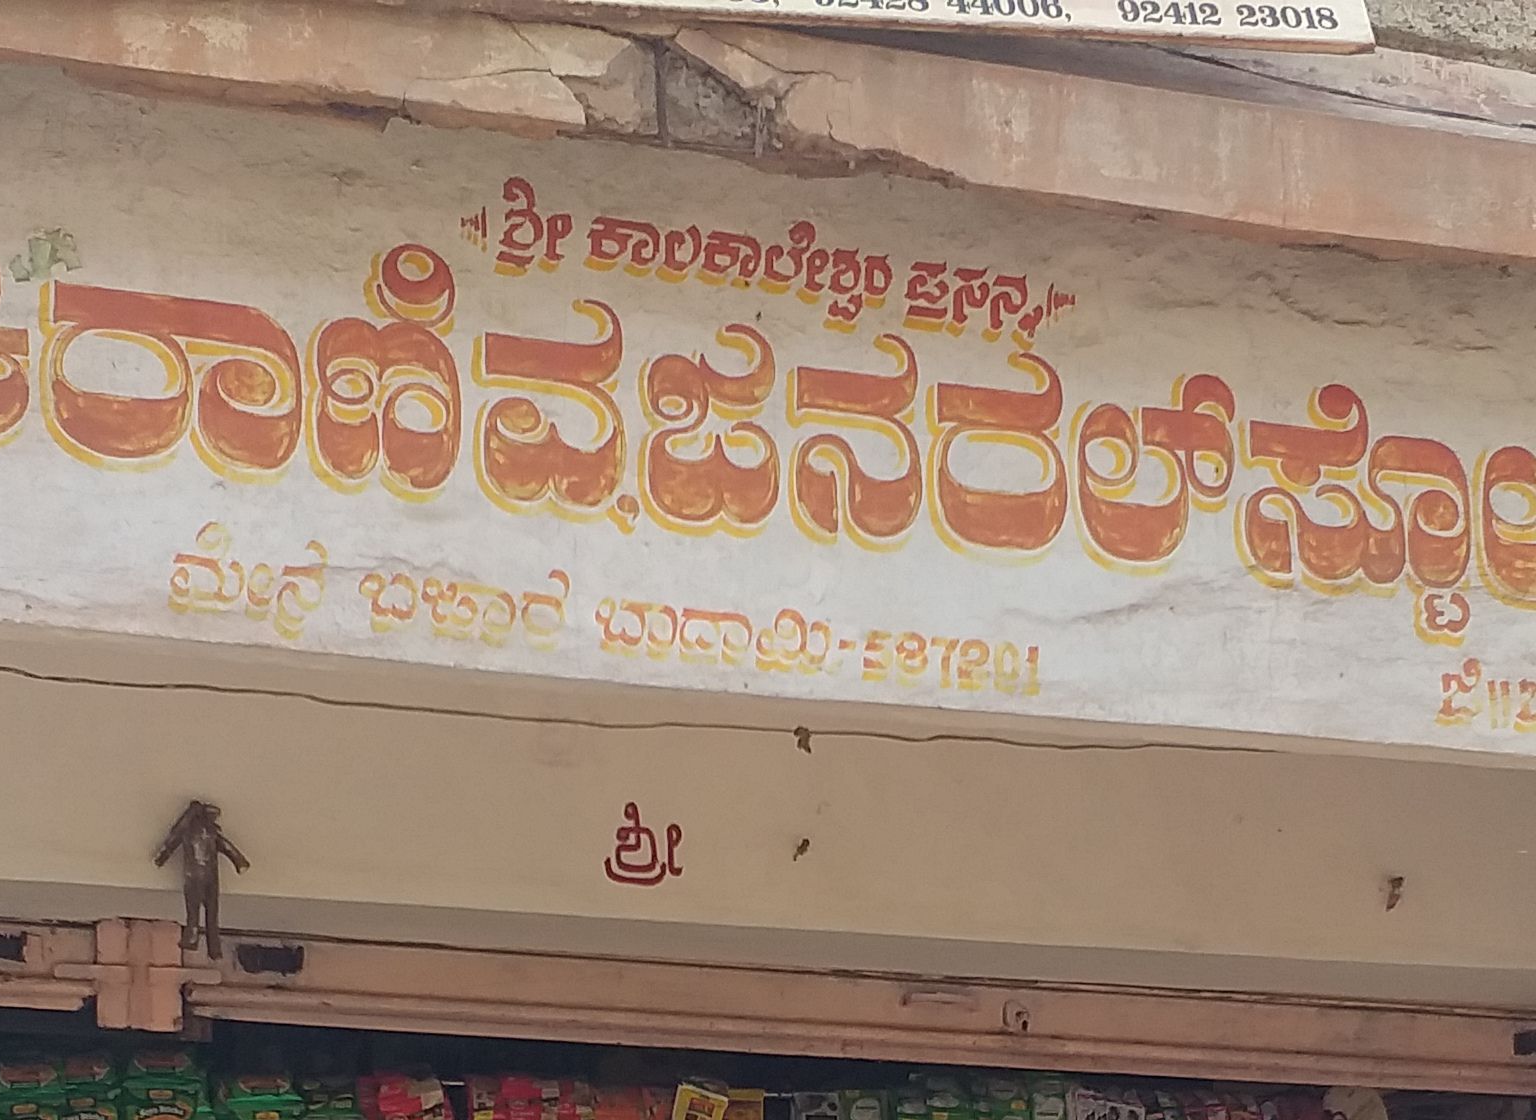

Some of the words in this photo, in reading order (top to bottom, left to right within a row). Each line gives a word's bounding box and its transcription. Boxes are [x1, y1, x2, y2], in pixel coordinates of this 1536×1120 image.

[1118, 0, 1223, 26] 92412
[1235, 4, 1339, 30] 23018
[494, 176, 574, 277] ಶ್ರೀ
[902, 260, 1046, 349] ಪ್ರಸನ್ನ
[604, 801, 684, 887] ಶ್ರೀ
